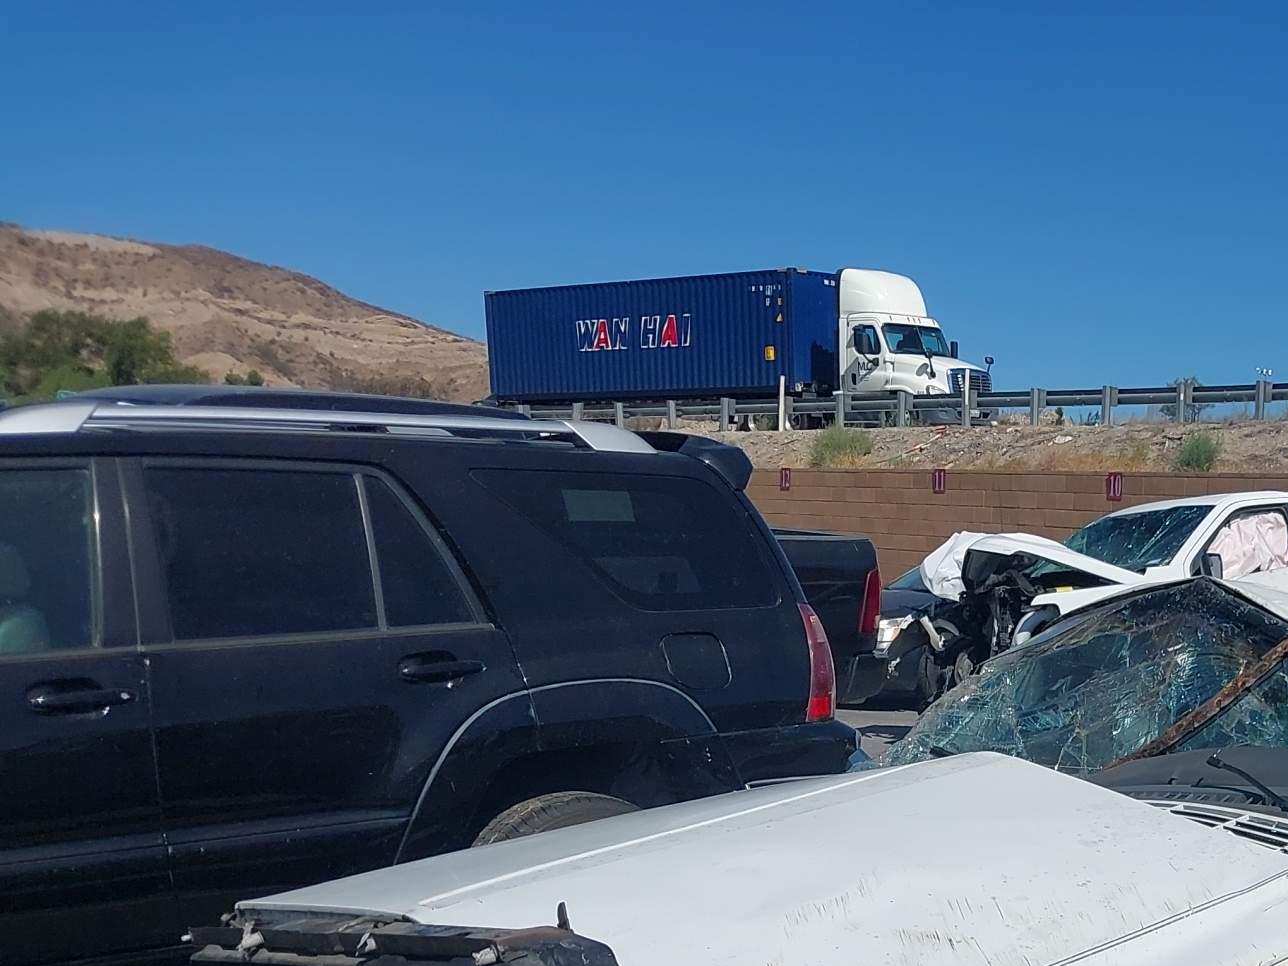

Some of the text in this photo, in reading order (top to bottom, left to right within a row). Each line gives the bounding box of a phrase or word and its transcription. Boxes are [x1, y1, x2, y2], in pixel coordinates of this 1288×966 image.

[576, 313, 691, 351] WAN HAI
[1109, 475, 1121, 496] 10
